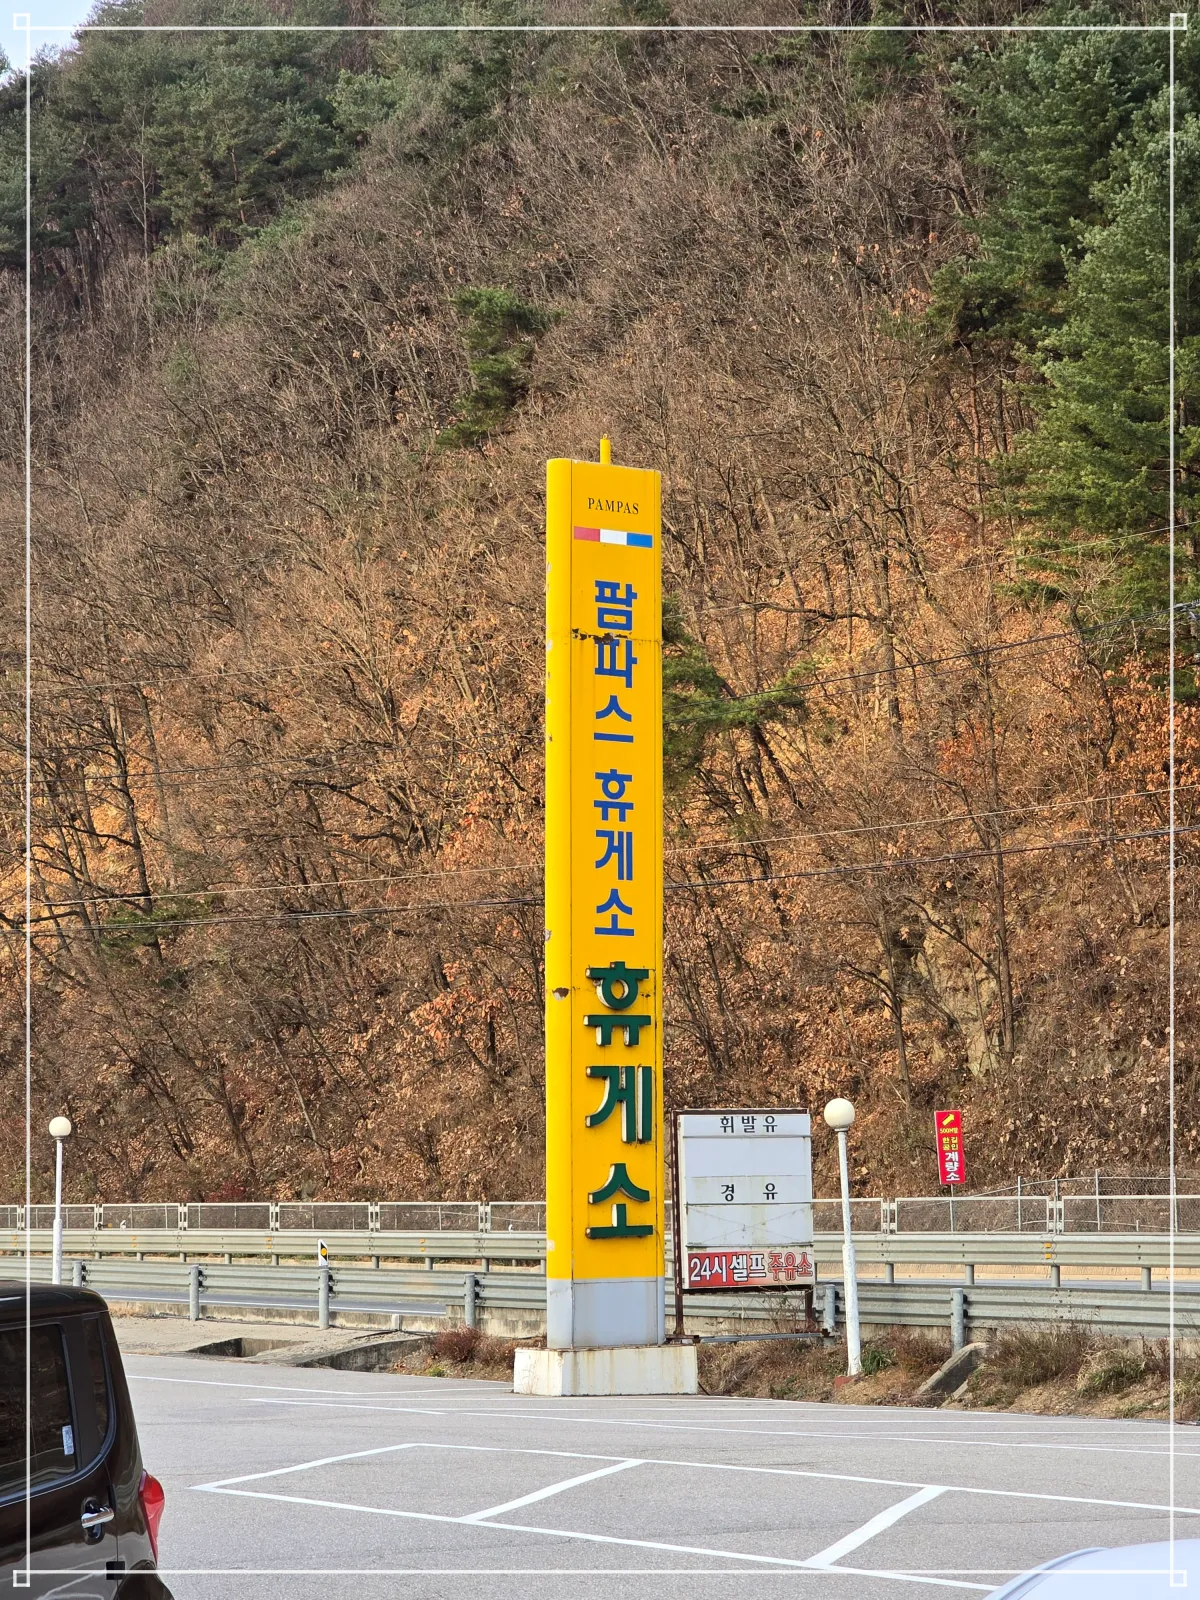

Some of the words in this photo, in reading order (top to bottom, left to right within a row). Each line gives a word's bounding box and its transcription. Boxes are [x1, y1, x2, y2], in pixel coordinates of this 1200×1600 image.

[587, 497, 640, 515] PAMPAS
[594, 580, 638, 743] 팜파스
[593, 768, 635, 937] 휴게소
[584, 961, 654, 1239] 휴게소
[719, 1115, 778, 1133] 휘발유
[945, 1151, 960, 1181] 계량소
[690, 1255, 727, 1282] 24시
[729, 1253, 767, 1282] 셀프
[768, 1252, 813, 1281] 주유소
